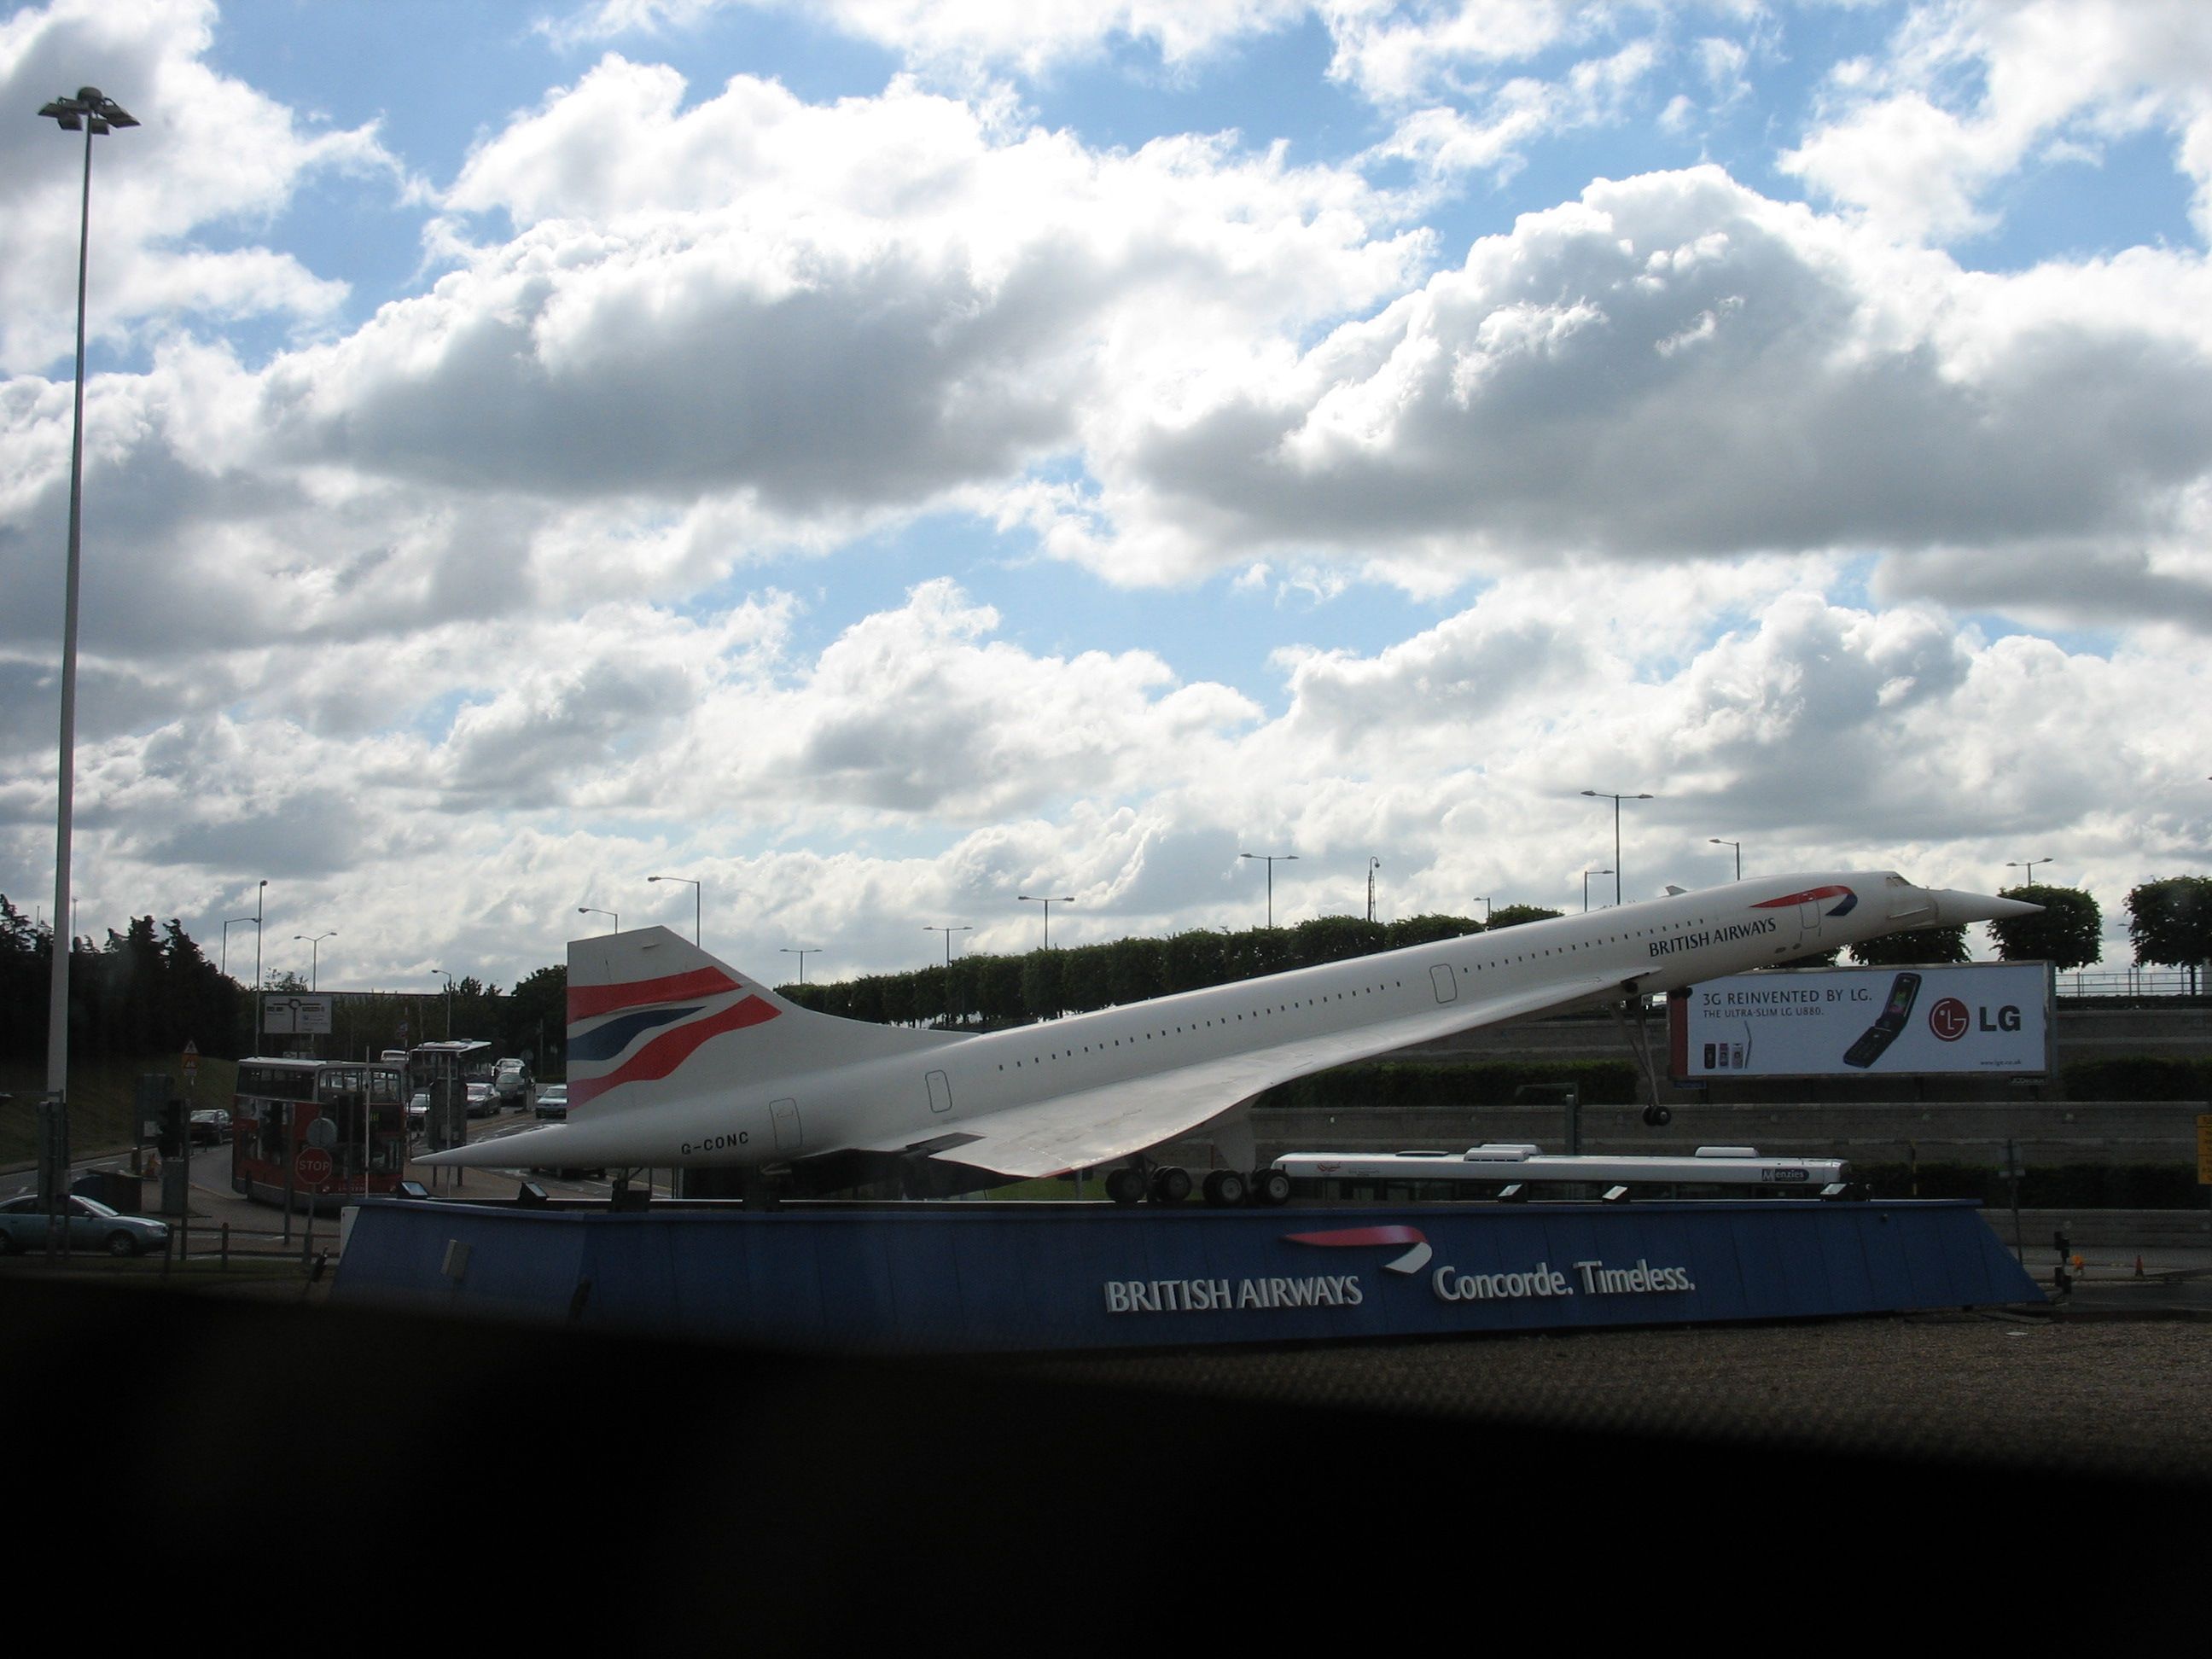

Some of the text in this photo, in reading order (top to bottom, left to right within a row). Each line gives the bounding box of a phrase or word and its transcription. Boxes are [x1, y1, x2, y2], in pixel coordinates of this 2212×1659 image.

[1649, 917, 1777, 958] BRITISH AIRWAYS
[1703, 988, 1872, 1006] 3G REINVENTED BY LG.
[1703, 1010, 1721, 1018] THE
[1725, 1008, 1778, 1018] ULTRA-SLIM
[1781, 1007, 1793, 1016] LG
[1979, 1004, 2021, 1032] LG
[681, 1132, 749, 1155] G-CONC
[299, 1161, 330, 1172] STOP
[1762, 1168, 1805, 1181] Menzies
[1432, 1258, 1696, 1302] Concorde. Timeless.
[1104, 1275, 1364, 1313] BRITISH AIRWAYS
